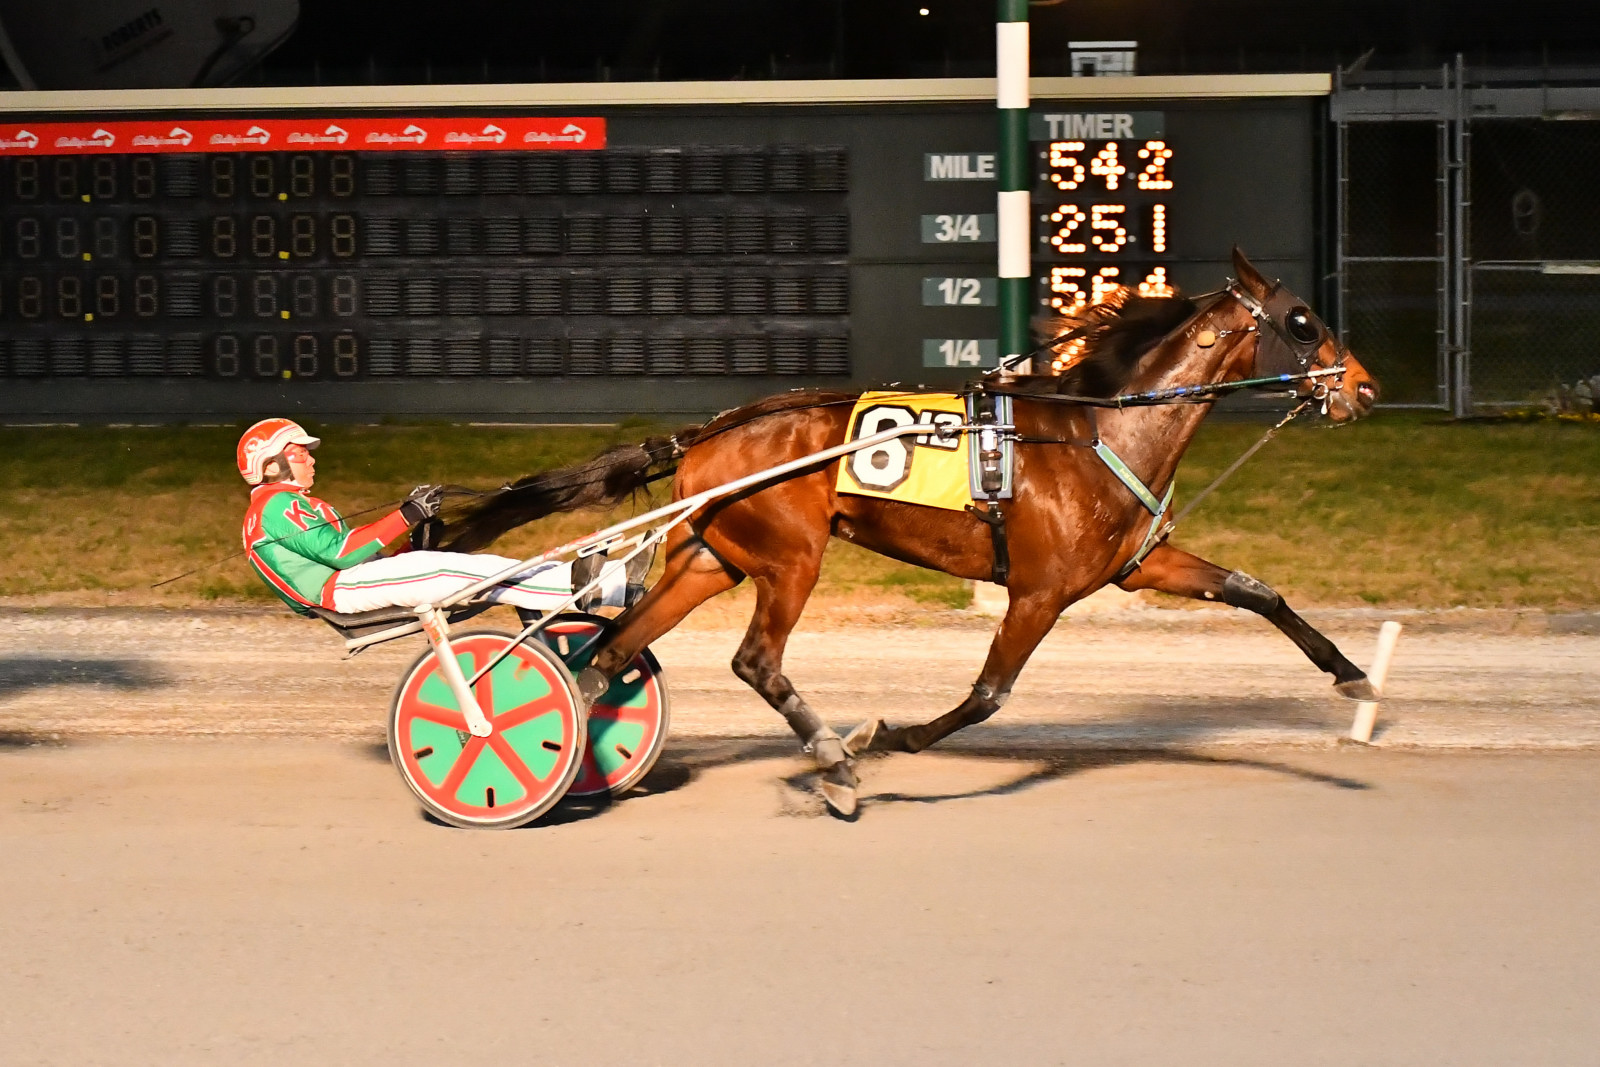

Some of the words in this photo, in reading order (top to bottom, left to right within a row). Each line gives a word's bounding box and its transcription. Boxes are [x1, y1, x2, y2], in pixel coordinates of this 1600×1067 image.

[1044, 113, 1135, 140] TIMER
[930, 155, 995, 179] MILE
[934, 214, 981, 242] 3/4
[938, 278, 982, 305] 1/2
[939, 339, 981, 366] 1/4
